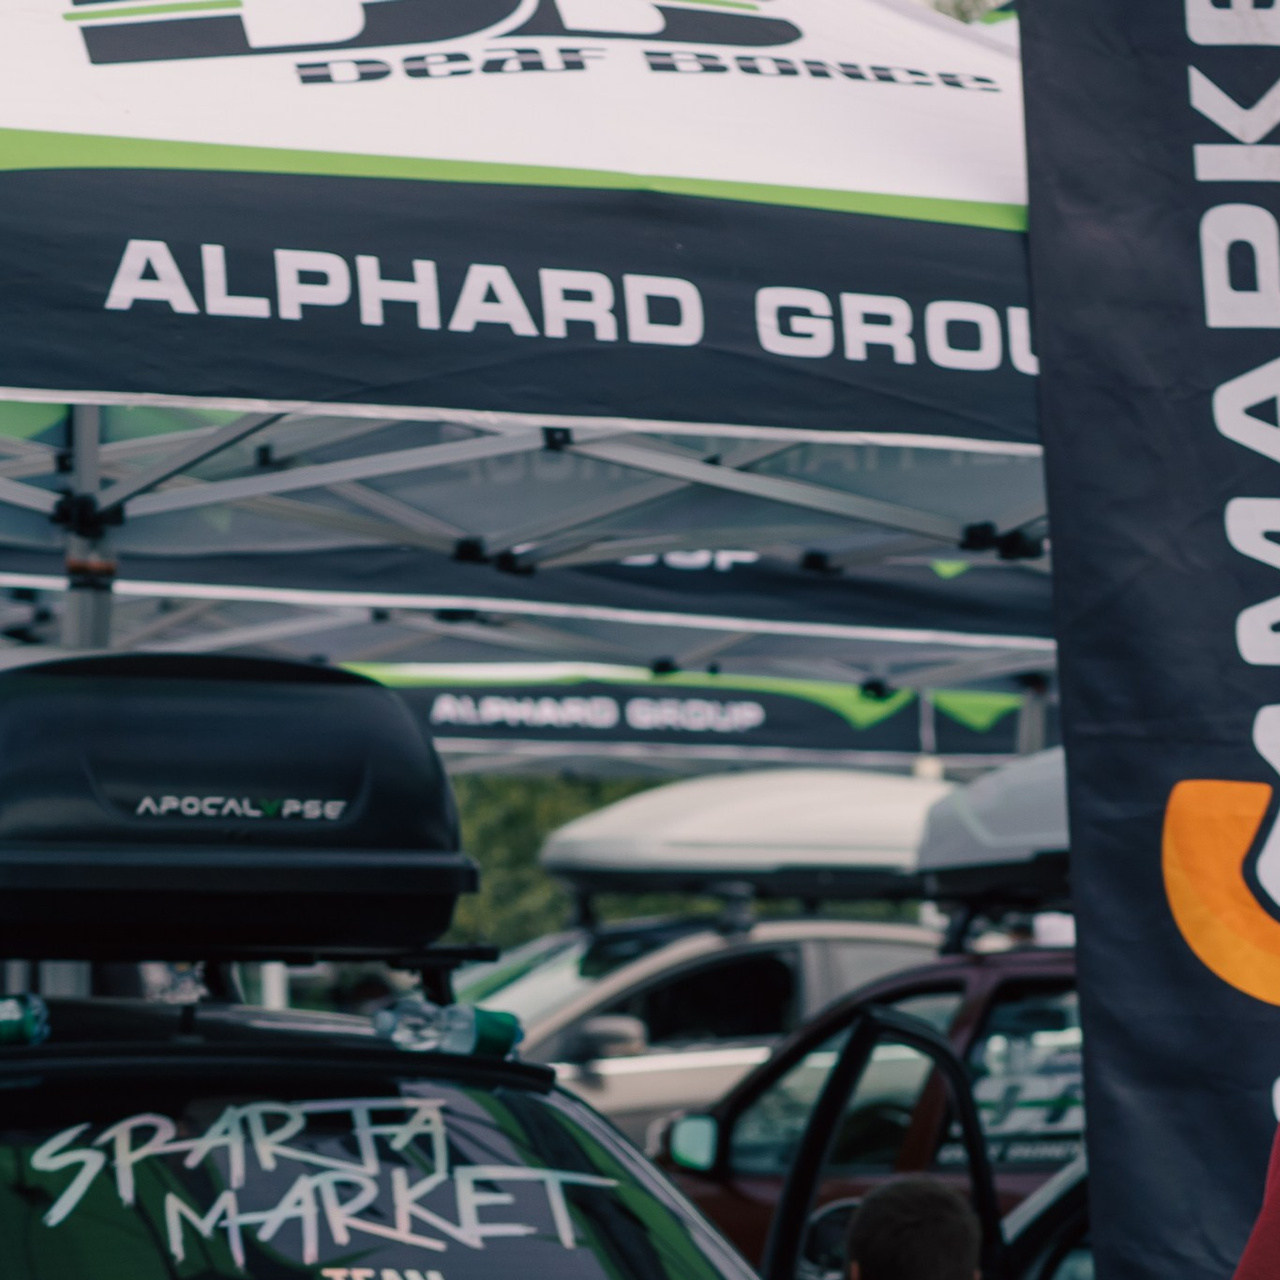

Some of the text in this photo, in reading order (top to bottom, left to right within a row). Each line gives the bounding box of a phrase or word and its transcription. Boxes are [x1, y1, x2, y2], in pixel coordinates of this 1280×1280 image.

[104, 238, 705, 347] ALPHARD
[430, 692, 767, 733] ALPHARD GROUP
[135, 795, 348, 820] APOCALYPSE
[31, 1099, 448, 1227] SPARTA
[164, 1162, 620, 1271] MARKET
